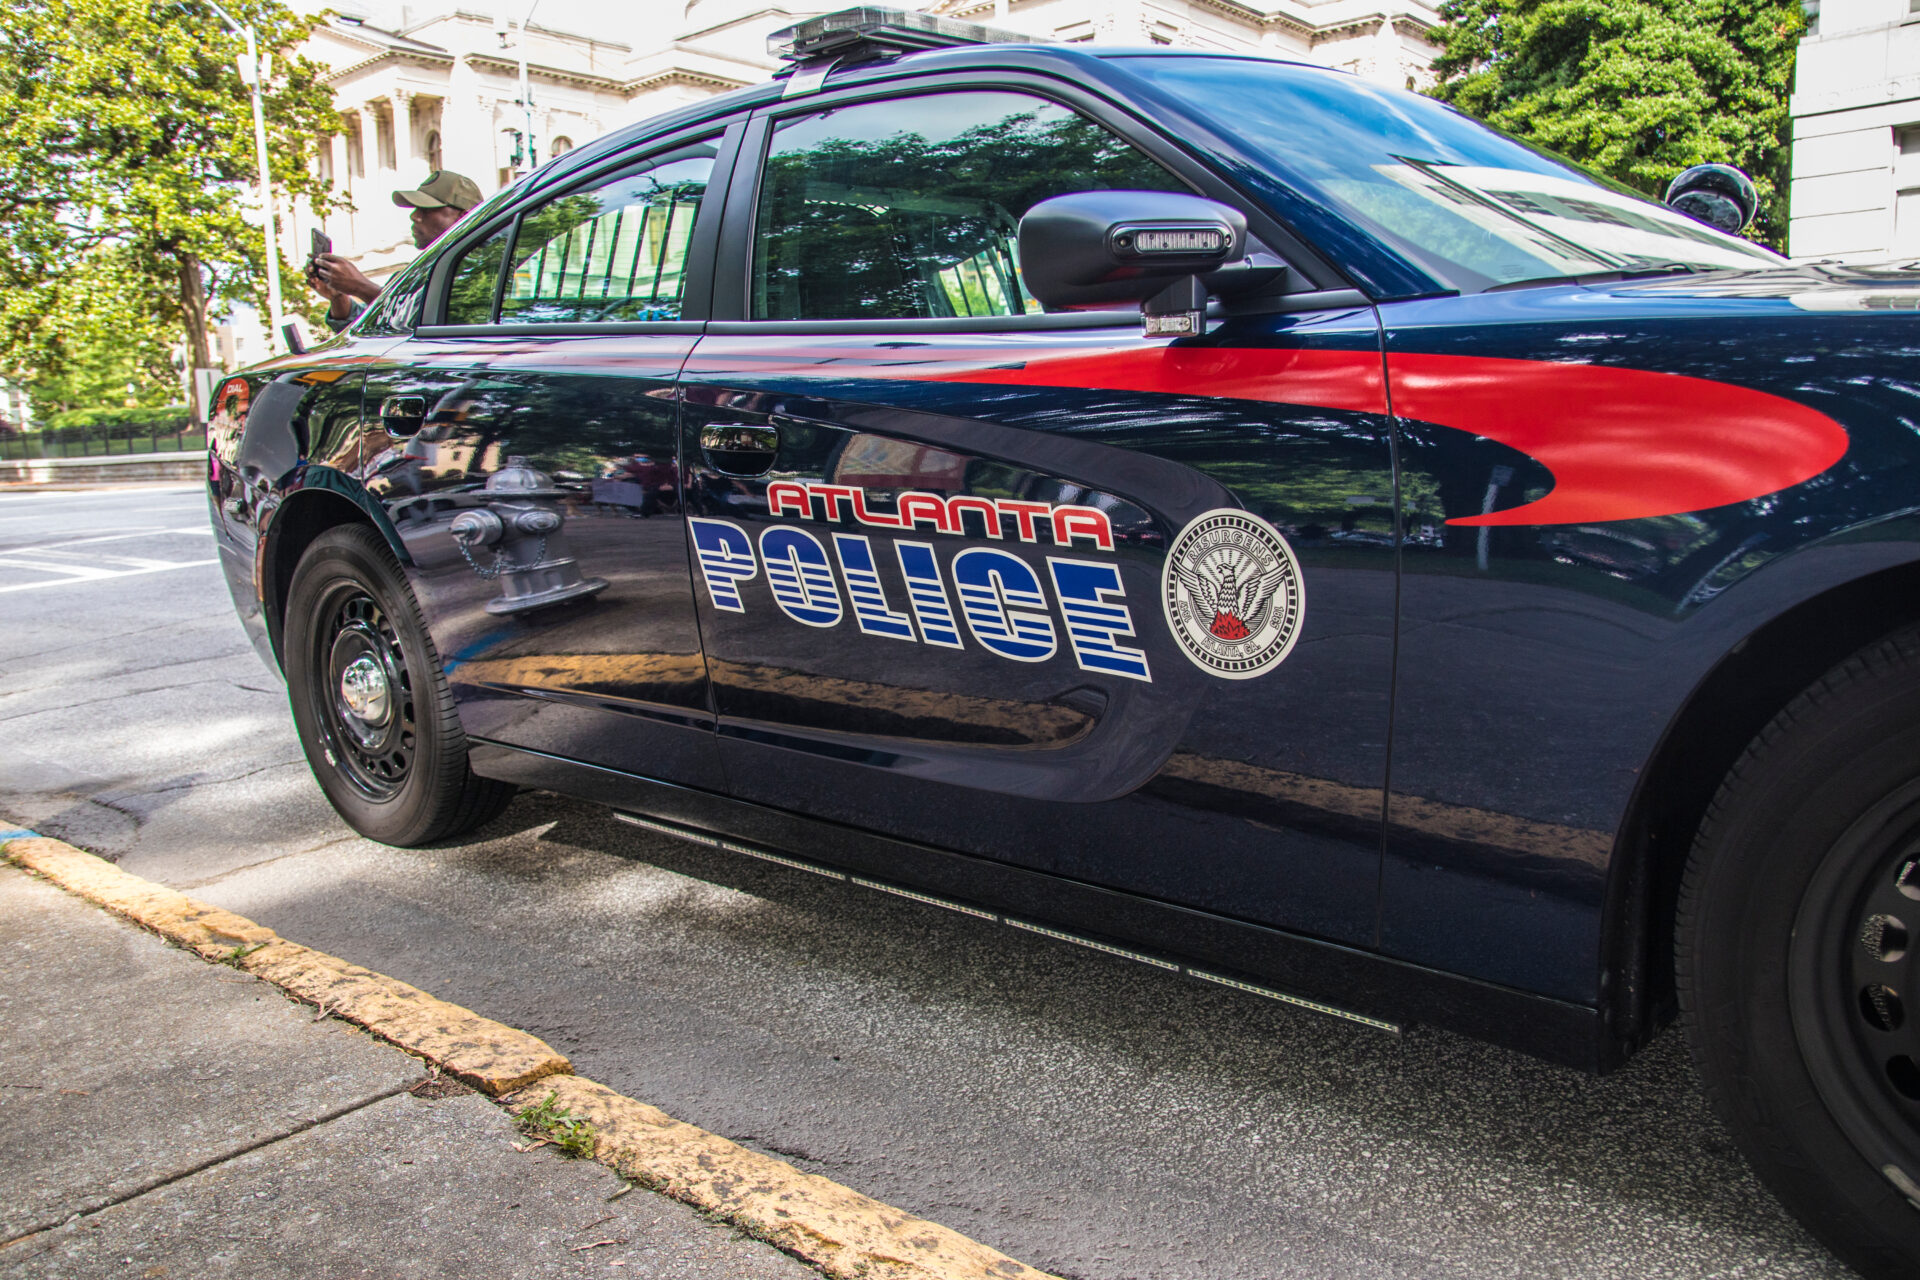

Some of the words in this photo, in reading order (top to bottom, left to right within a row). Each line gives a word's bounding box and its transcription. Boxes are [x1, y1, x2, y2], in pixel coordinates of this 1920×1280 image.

[226, 383, 243, 394] DIAL
[767, 480, 1115, 551] ATLANTA
[1186, 529, 1274, 567] RESURGENS
[687, 516, 1153, 683] POLICE
[1270, 606, 1285, 631] 1865
[1201, 637, 1244, 658] ATLANTA,
